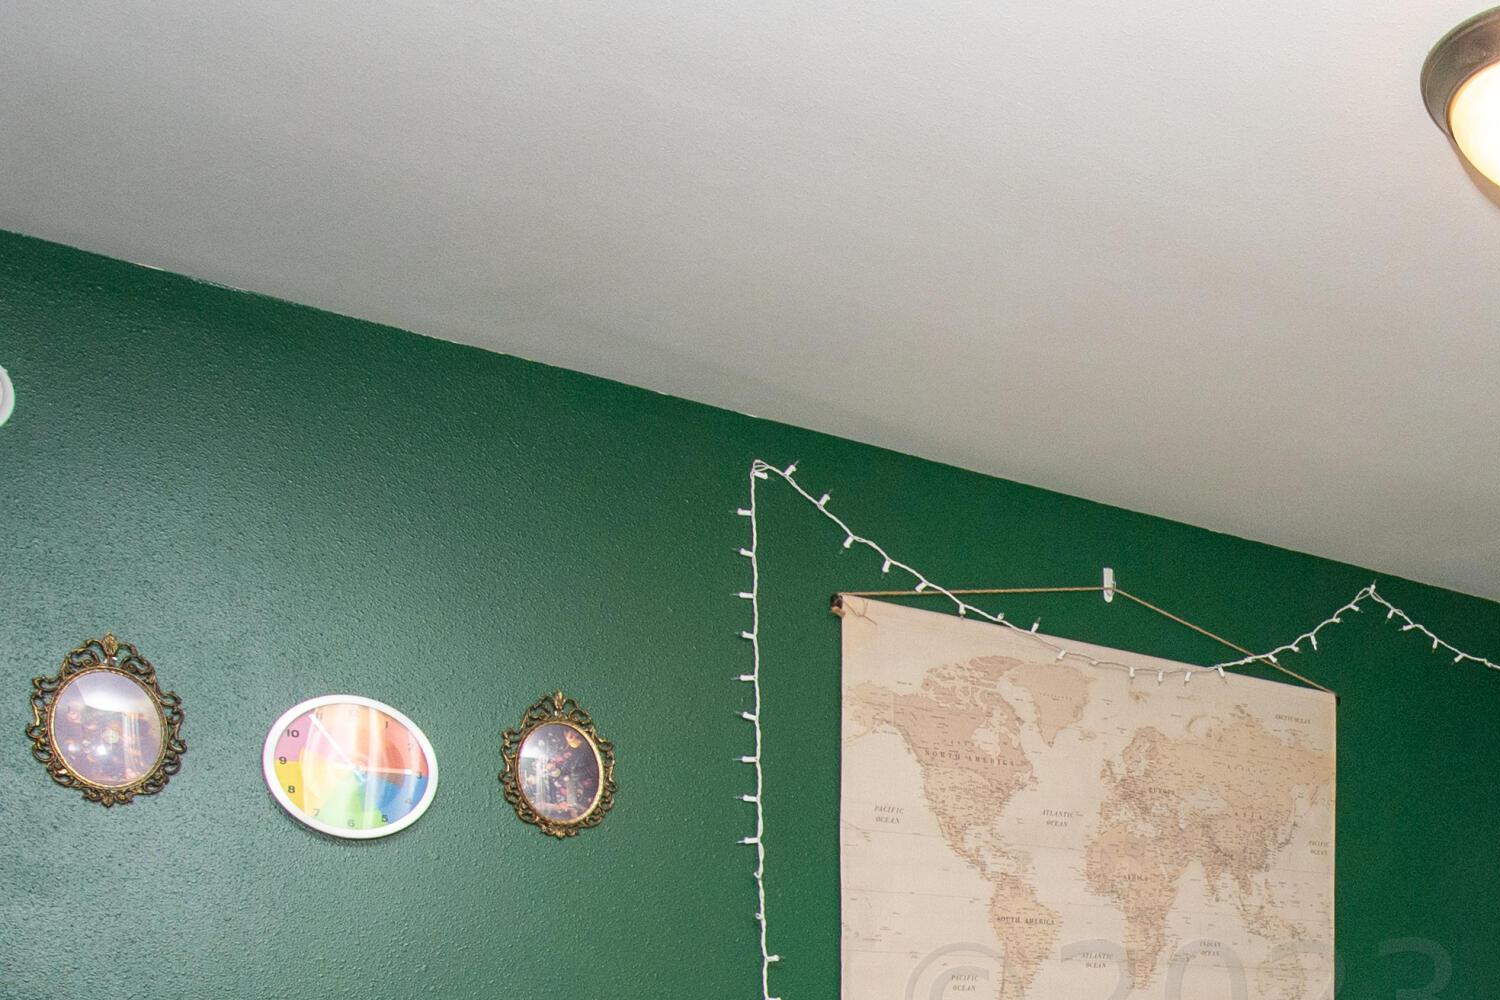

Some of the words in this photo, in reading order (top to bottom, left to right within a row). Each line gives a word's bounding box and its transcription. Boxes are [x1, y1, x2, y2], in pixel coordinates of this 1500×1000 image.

[286, 728, 300, 739] 10
[925, 749, 960, 760] NORTH
[278, 756, 288, 765] 9
[287, 784, 296, 794] 8
[311, 807, 321, 817] 7
[874, 804, 904, 814] PACIFIC
[1042, 808, 1074, 818] ATLANTIC
[345, 818, 356, 828] 6
[381, 813, 389, 823] 5
[876, 816, 900, 825] OCEAN
[1046, 819, 1068, 828] OCEAN
